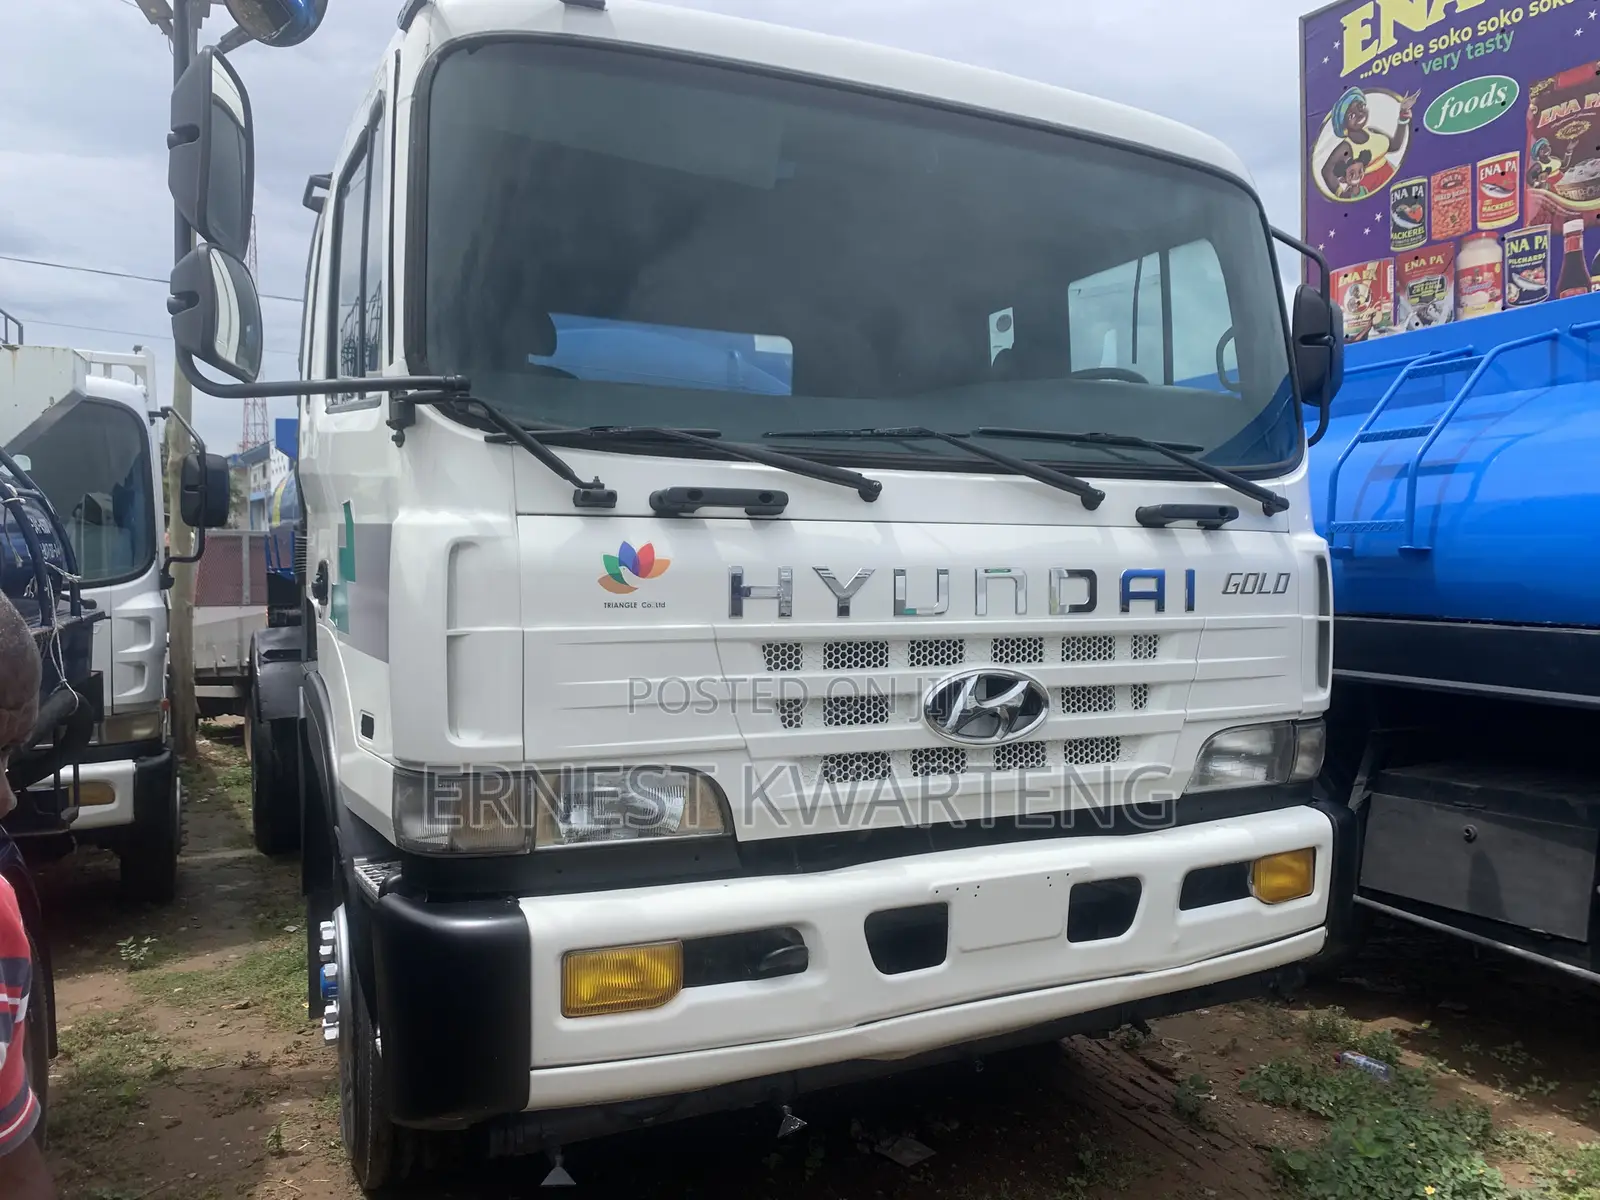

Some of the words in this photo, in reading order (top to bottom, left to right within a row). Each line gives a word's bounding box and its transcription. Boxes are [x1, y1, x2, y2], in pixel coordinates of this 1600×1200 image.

[1429, 26, 1472, 54] soko
[1477, 7, 1524, 36] soko
[1422, 49, 1461, 75] very
[1466, 30, 1514, 60] tasty
[1434, 81, 1509, 129] foods
[1536, 98, 1581, 128] ENA
[1480, 163, 1501, 181] ENA
[1505, 160, 1517, 172] PA
[1412, 185, 1424, 197] PA
[1534, 235, 1548, 249] PA
[1405, 258, 1426, 272] ENA
[1429, 254, 1444, 265] PA
[728, 565, 1195, 618] HYUNDAI
[1221, 572, 1291, 595] GOLD
